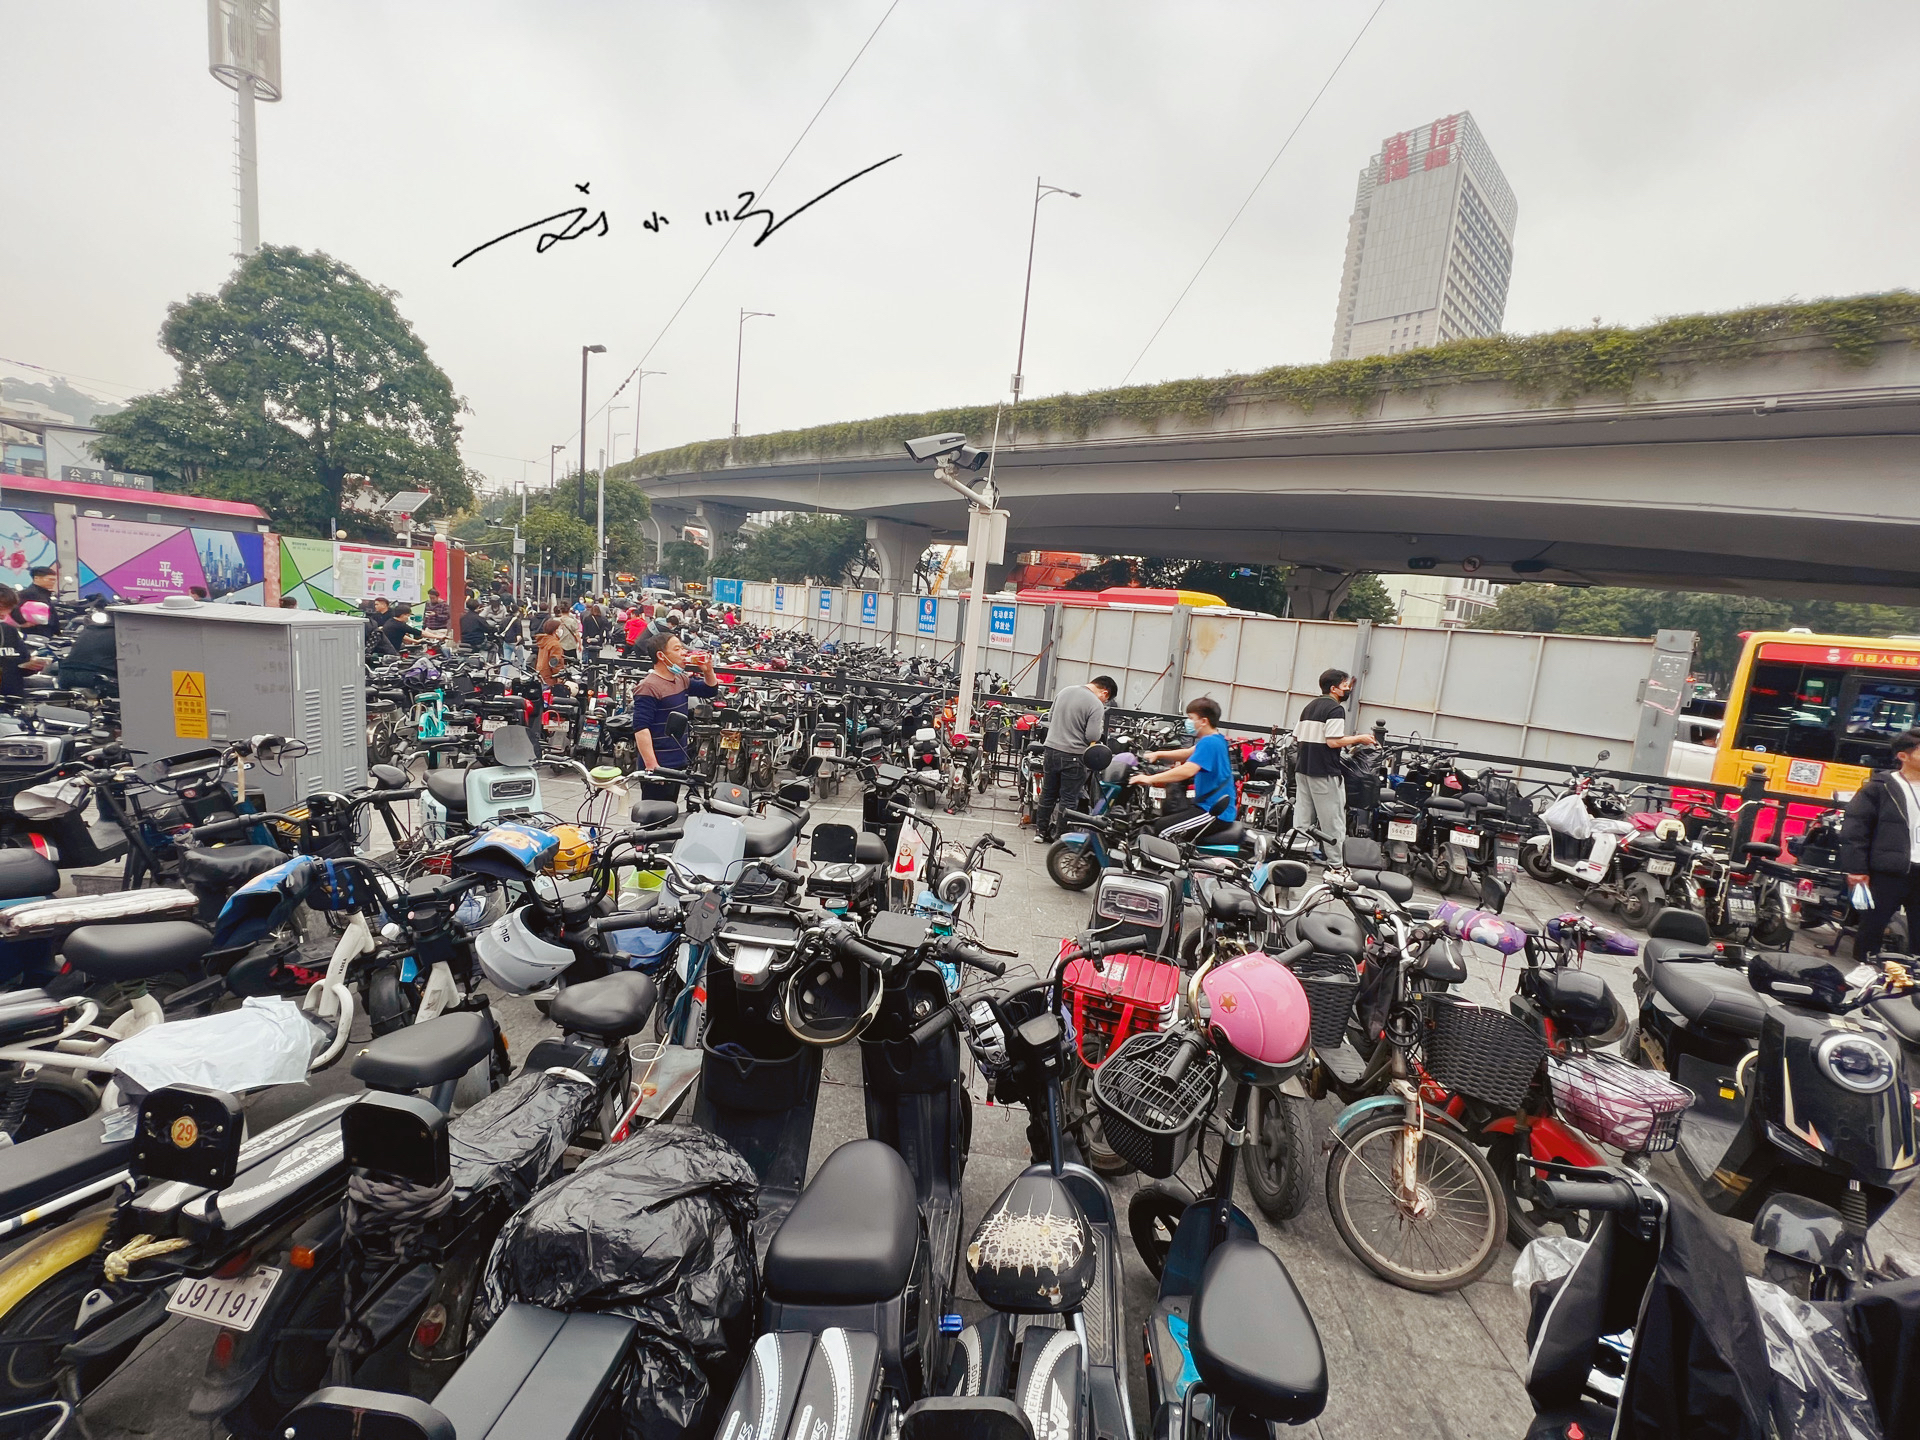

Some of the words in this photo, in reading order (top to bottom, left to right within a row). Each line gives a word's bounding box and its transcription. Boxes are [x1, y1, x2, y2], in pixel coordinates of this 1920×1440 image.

[136, 577, 170, 588] EQUALITY
[158, 561, 184, 588] 平等
[993, 610, 1014, 620] 电动单车
[994, 620, 1010, 631] 停放处
[1853, 653, 1919, 666] 机器人教练
[176, 1122, 194, 1142] 29
[177, 1281, 258, 1322] J91191
[1028, 1371, 1045, 1416] VEHICLE
